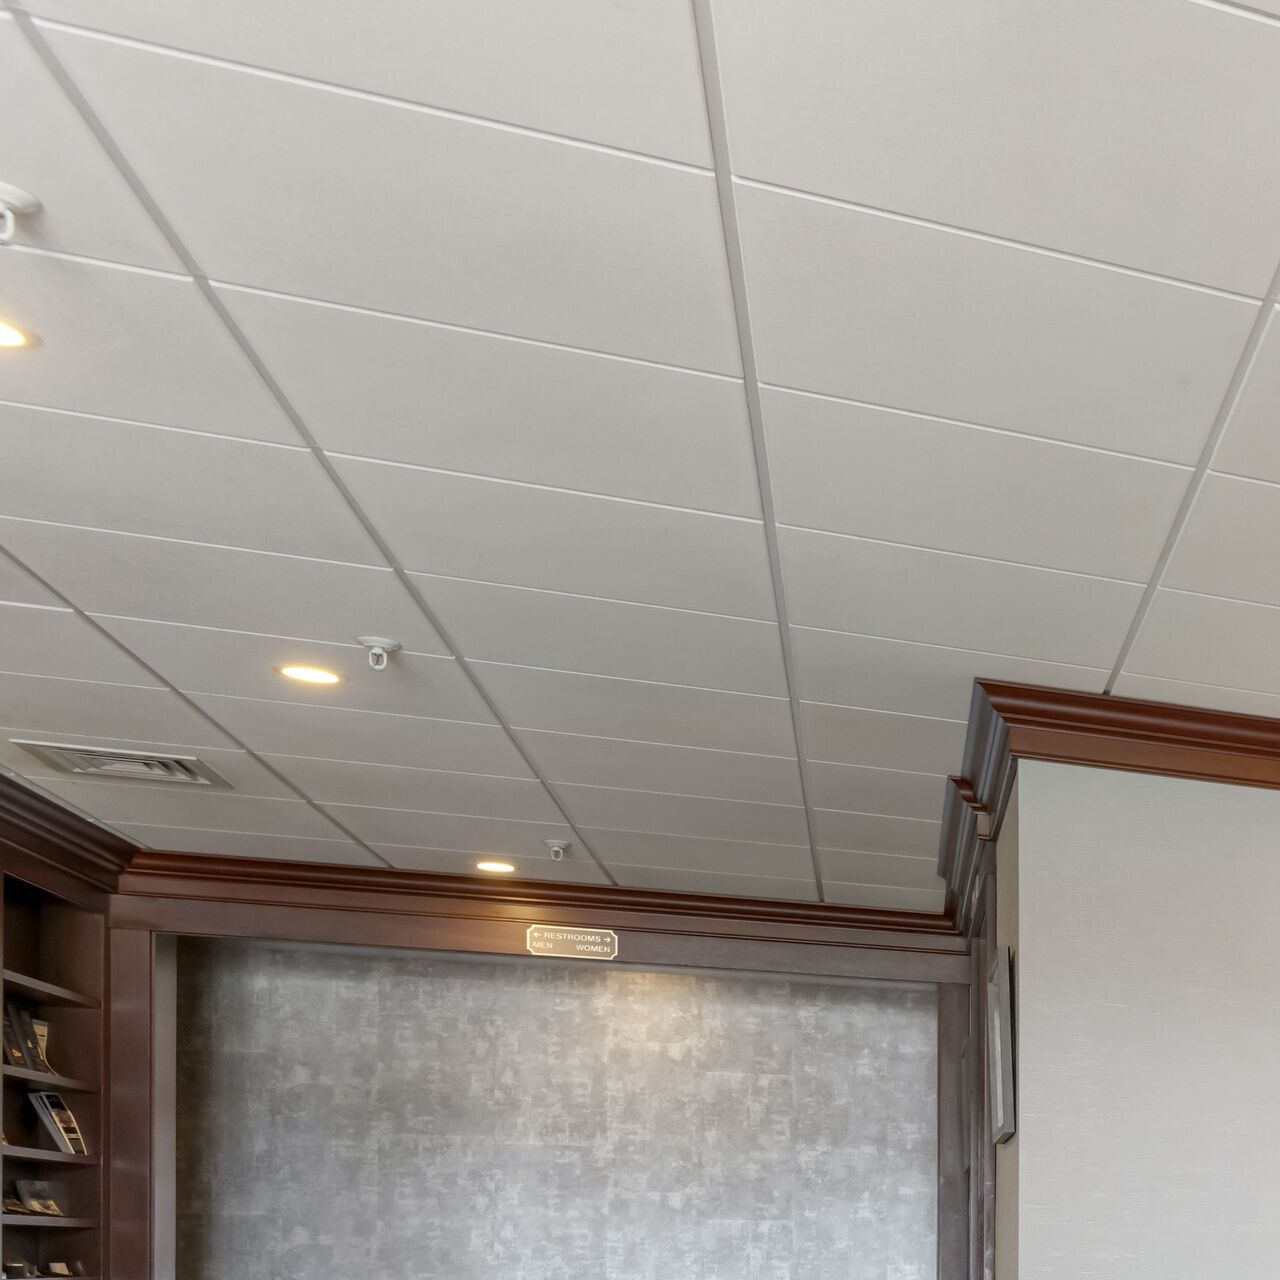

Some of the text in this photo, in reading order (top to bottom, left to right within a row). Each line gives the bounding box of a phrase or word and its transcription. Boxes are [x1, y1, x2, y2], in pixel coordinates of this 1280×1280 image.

[544, 932, 602, 942] RESTROOMS
[532, 941, 611, 953] MEN WOMEN
